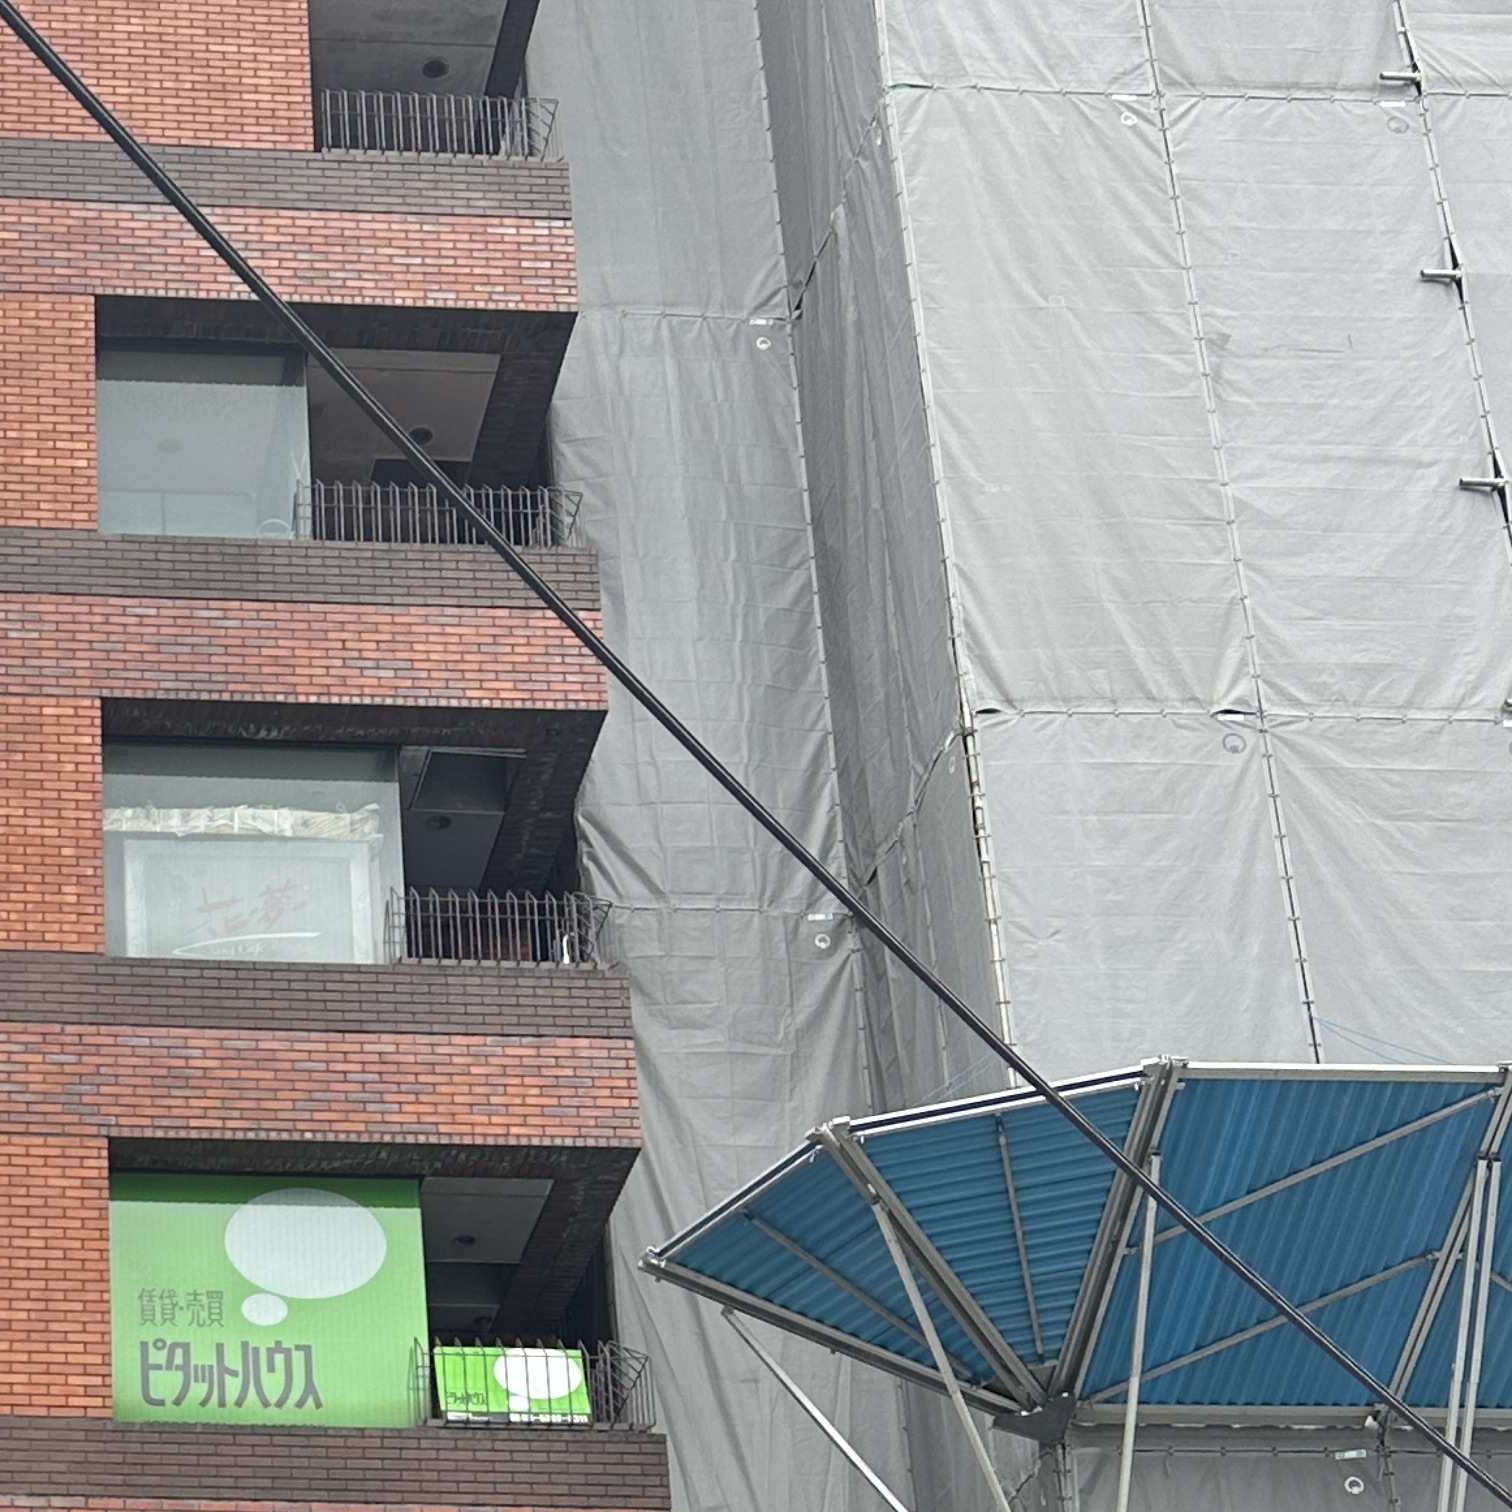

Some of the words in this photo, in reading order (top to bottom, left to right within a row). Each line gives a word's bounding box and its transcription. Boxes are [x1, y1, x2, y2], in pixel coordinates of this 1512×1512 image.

[139, 1338, 324, 1410] ピタットハウス
